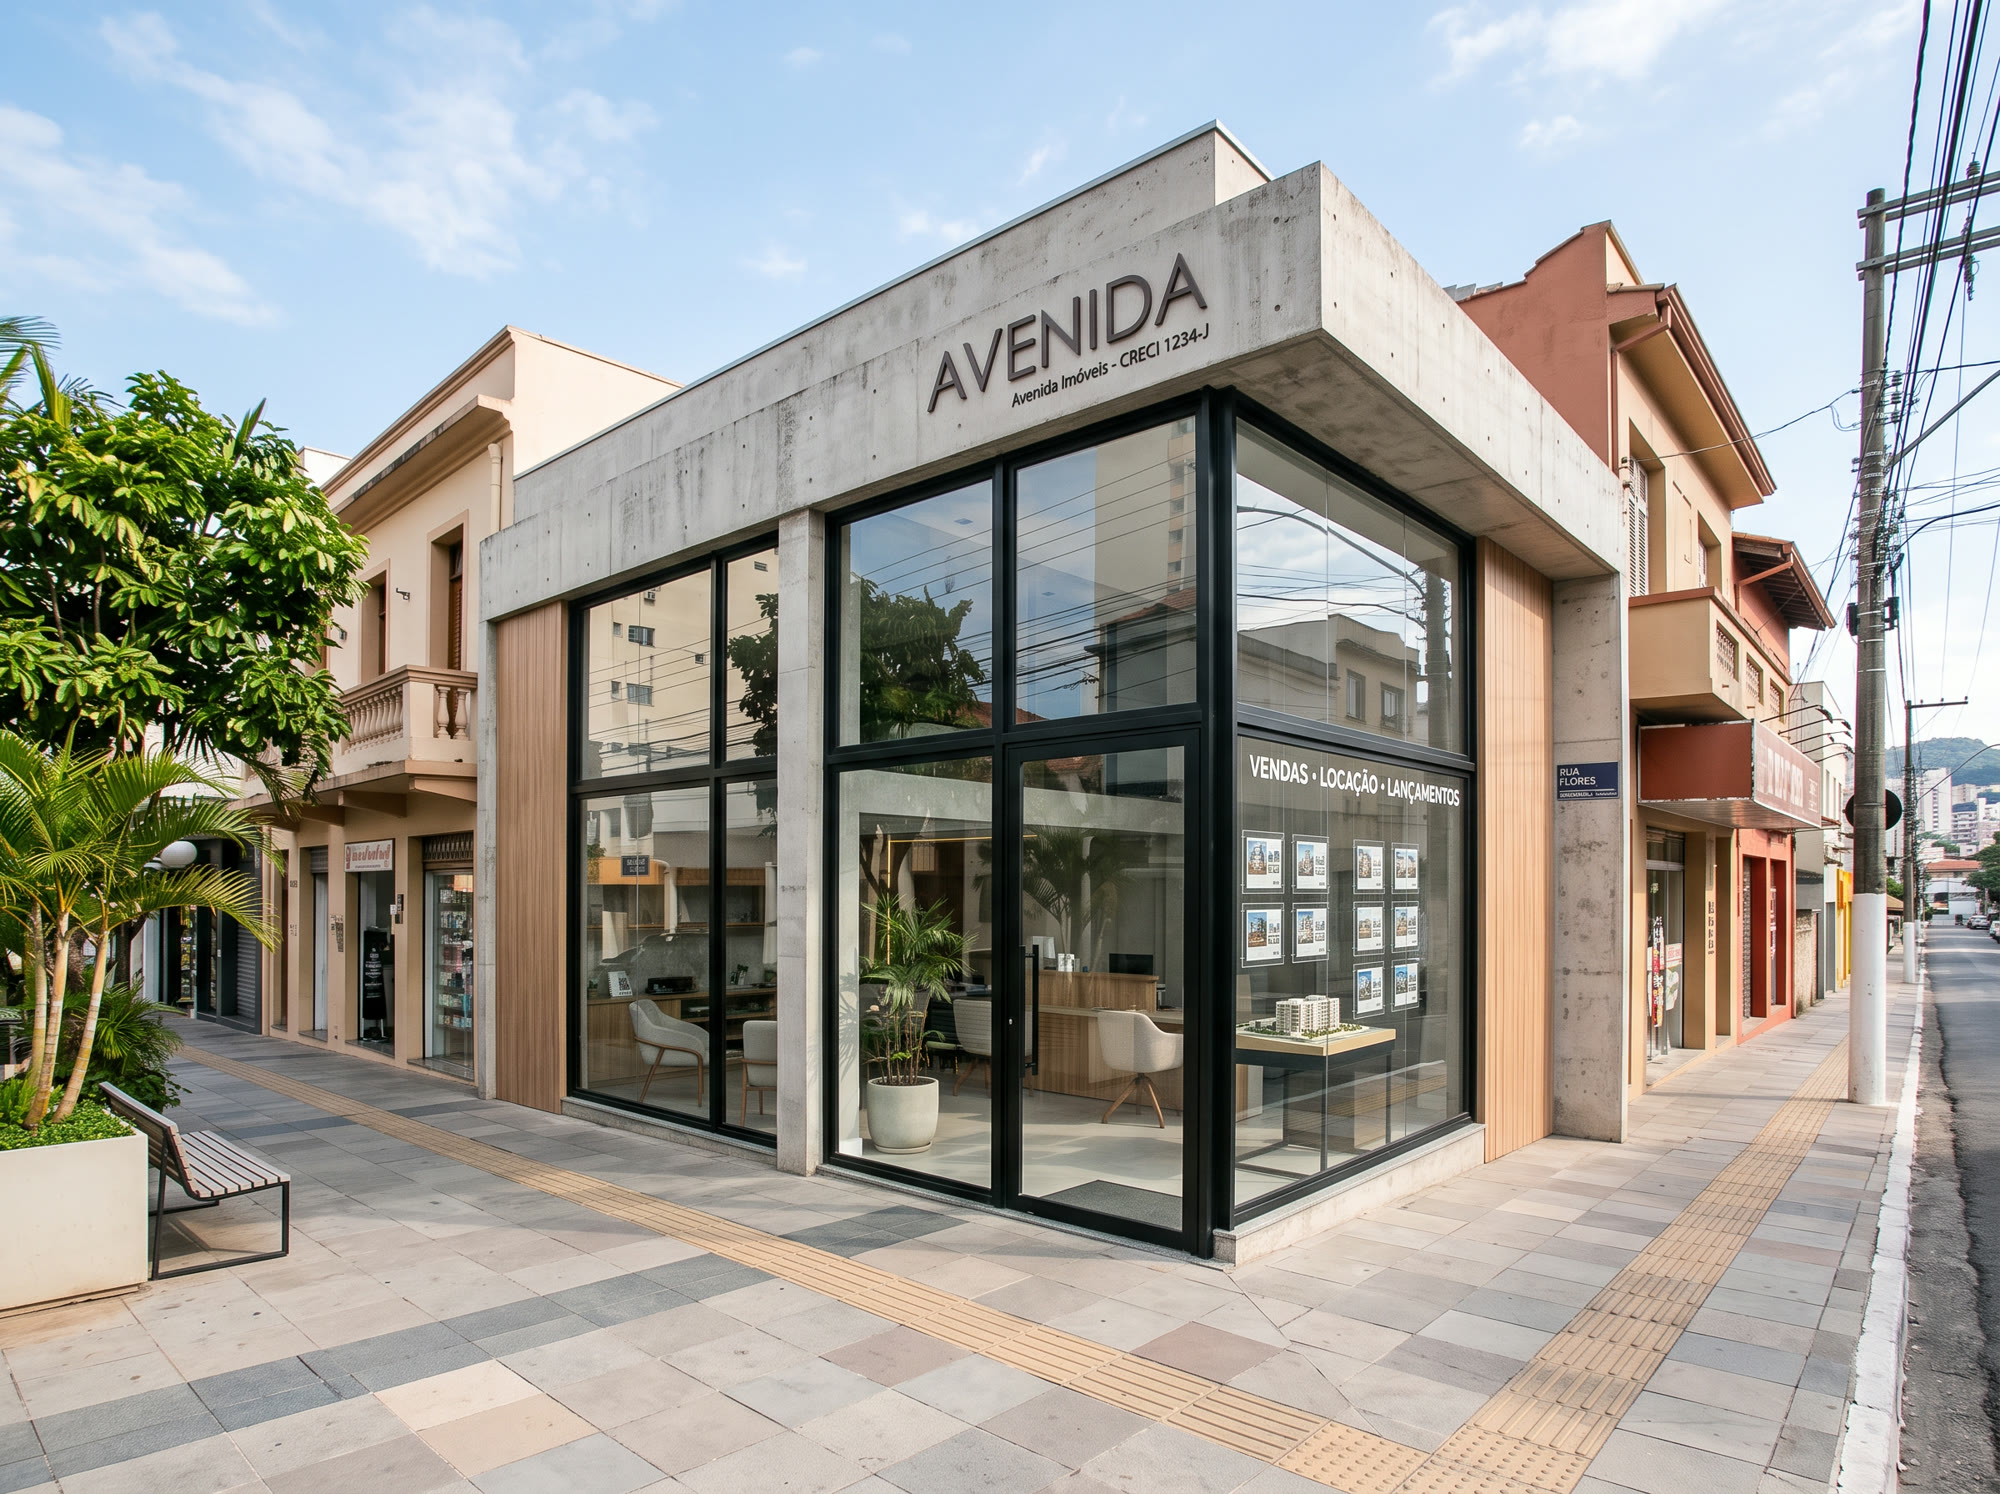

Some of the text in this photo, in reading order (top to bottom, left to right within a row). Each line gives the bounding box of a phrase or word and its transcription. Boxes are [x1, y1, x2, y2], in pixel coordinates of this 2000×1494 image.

[927, 252, 1208, 413] AVENIDA
[1011, 379, 1058, 408] Avenida
[1061, 362, 1108, 389] Imóveis
[1120, 341, 1160, 368] CRECI
[1164, 323, 1210, 352] 1234-J
[1249, 755, 1309, 784] VENDAS
[1320, 768, 1378, 797] LOCAÇÃO
[1387, 777, 1460, 807] LANÇAMENTOS
[1560, 768, 1580, 776] RUA
[1560, 776, 1596, 786] FLORES
